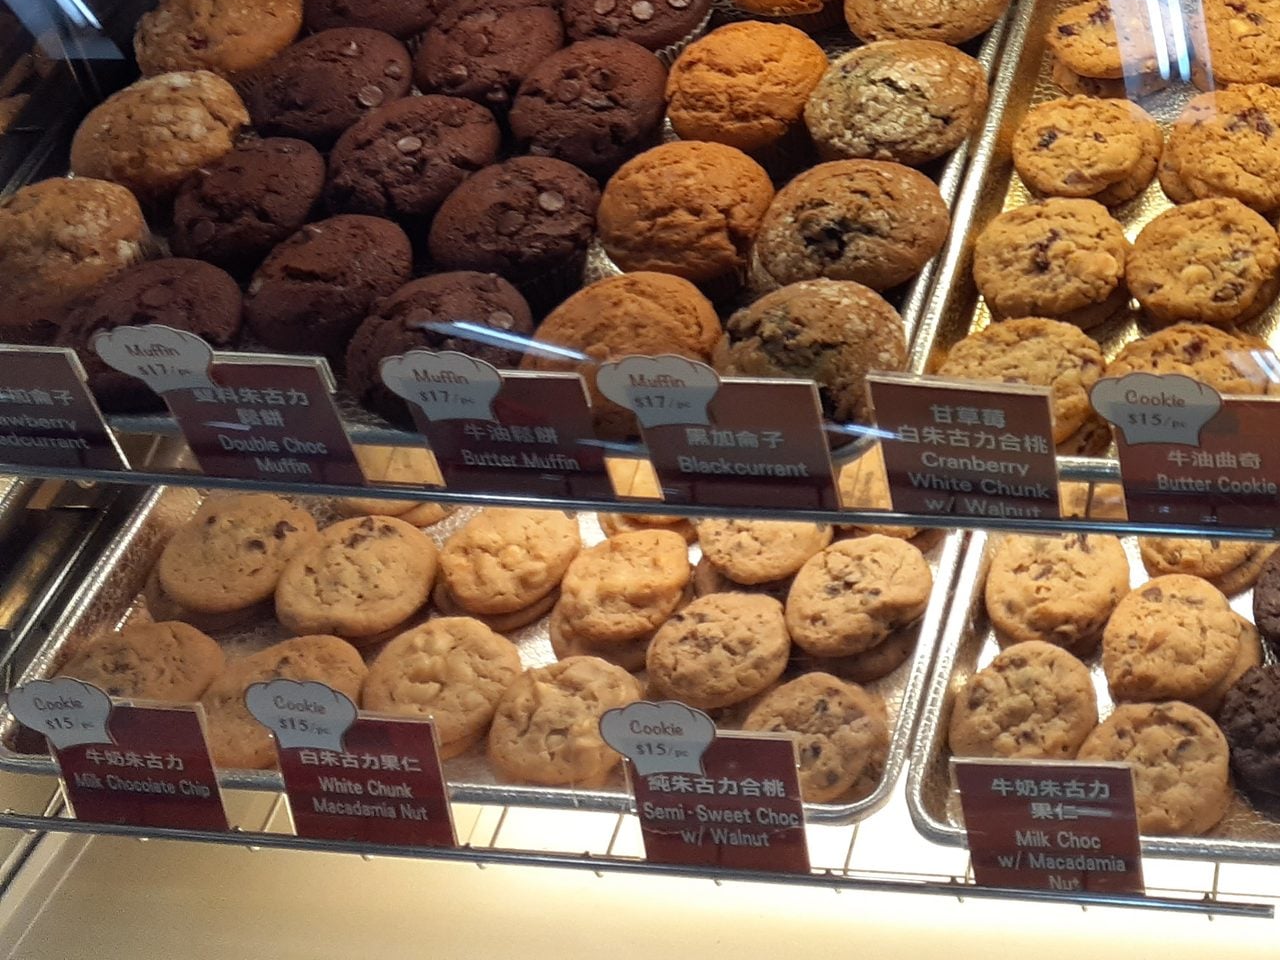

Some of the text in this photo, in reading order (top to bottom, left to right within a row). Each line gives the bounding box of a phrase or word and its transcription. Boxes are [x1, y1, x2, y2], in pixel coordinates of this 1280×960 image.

[124, 343, 181, 358] Muffin
[412, 369, 469, 385] Muffin
[628, 373, 686, 389] Muffin
[1124, 390, 1186, 408] Cookie
[217, 434, 328, 455] Double Choc
[898, 424, 1049, 454] 白朱古力合桃
[254, 456, 312, 474] Muffin
[460, 448, 581, 471] Butter Muffin
[676, 455, 810, 478] Blackcurrent
[921, 451, 1030, 477] Cranberry
[1167, 449, 1262, 470] 牛油曲奇
[908, 471, 1050, 499] White Chunk
[1157, 473, 1278, 495] Butter Cookie
[964, 497, 1042, 519] Walnut
[34, 695, 84, 711] Cookie
[273, 695, 327, 715] Cookie
[629, 720, 684, 737] Cookie
[85, 749, 184, 771] 牛奶朱古力
[300, 749, 422, 773] 白朱古力果仁
[73, 772, 210, 798] Milk Chocolate Chip
[318, 776, 414, 799] White Chunk
[647, 775, 786, 798] 純朱古力合桃
[991, 778, 1110, 799] 牛奶朱古力
[312, 797, 428, 821] Macadamia Nut
[756, 809, 800, 827] Choc
[1031, 802, 1078, 820] 果仁
[681, 827, 770, 847] w/ Walnut
[1015, 830, 1101, 850] Milk Choc
[998, 851, 1126, 872] w/ Macadamia
